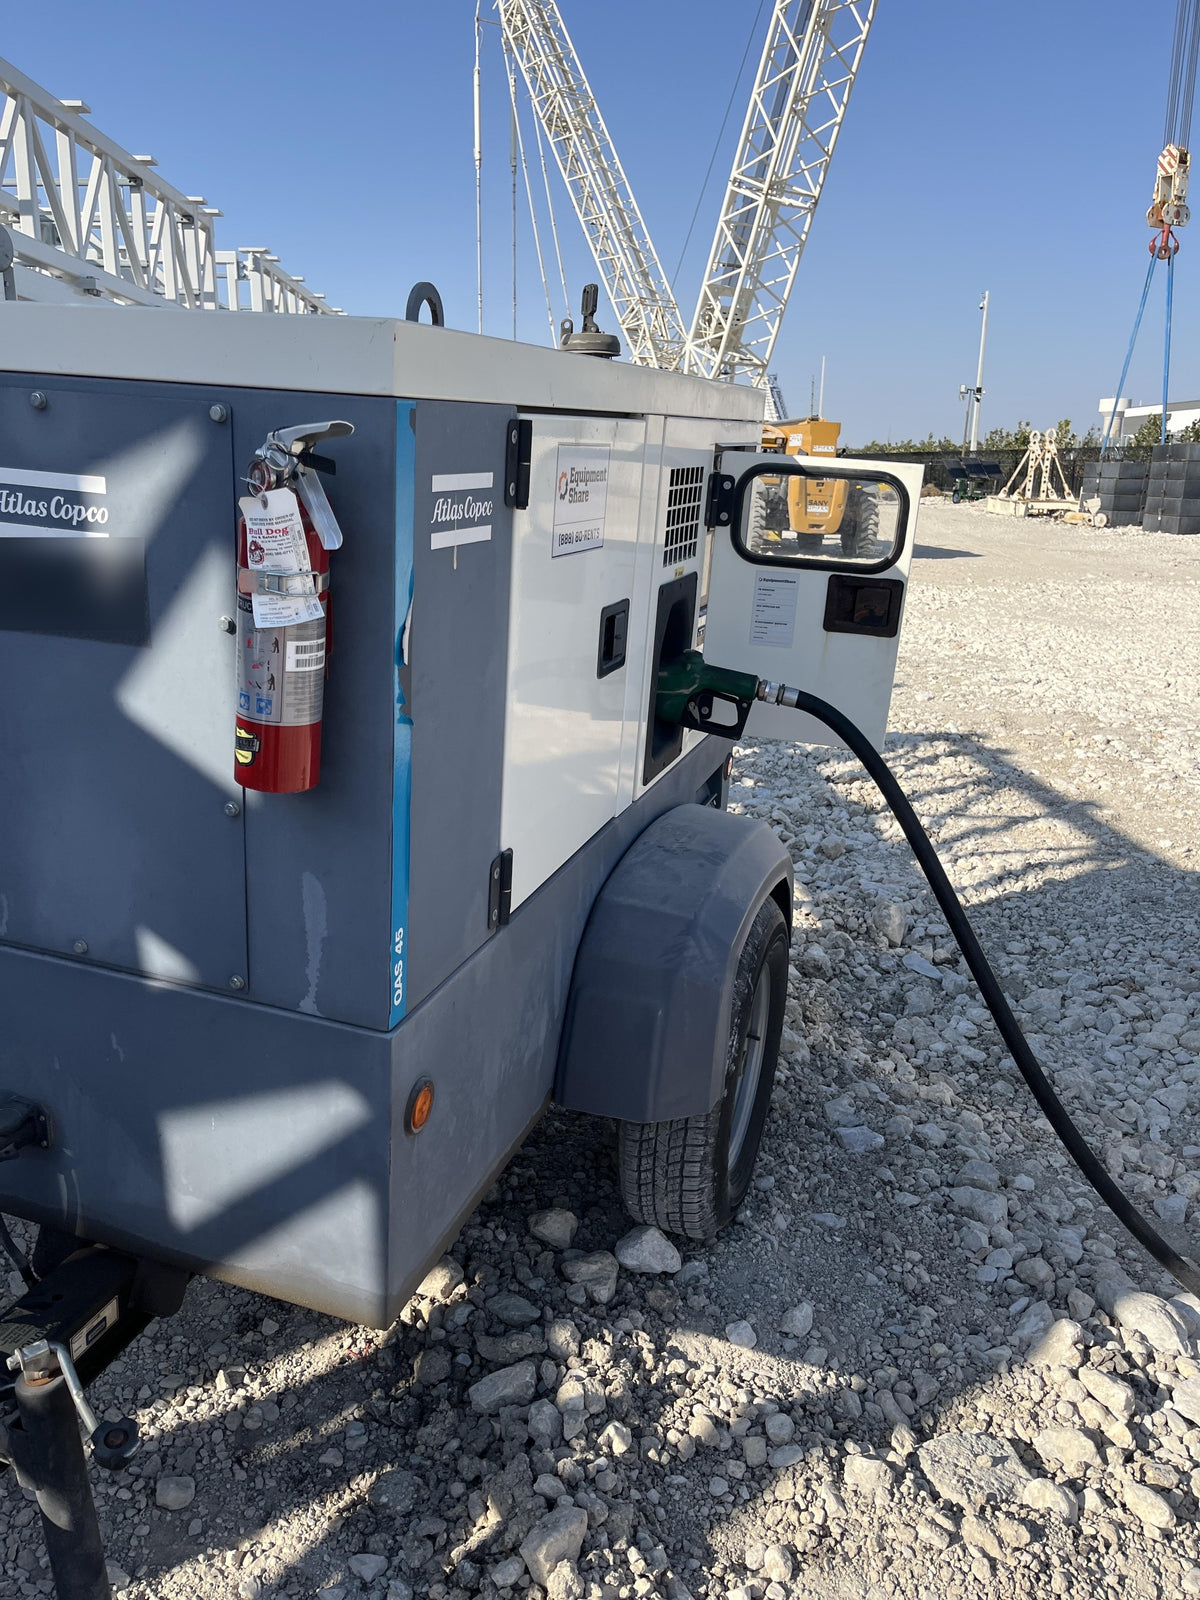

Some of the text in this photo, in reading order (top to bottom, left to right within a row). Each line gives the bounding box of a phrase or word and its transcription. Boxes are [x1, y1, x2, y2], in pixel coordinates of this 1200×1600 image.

[570, 467, 607, 487] Equipment
[568, 487, 589, 504] Share
[50, 496, 109, 526] Copco
[430, 495, 493, 524] Atlas Copco
[265, 526, 289, 536] Dog
[558, 530, 575, 547] (888)
[394, 927, 404, 954] 45
